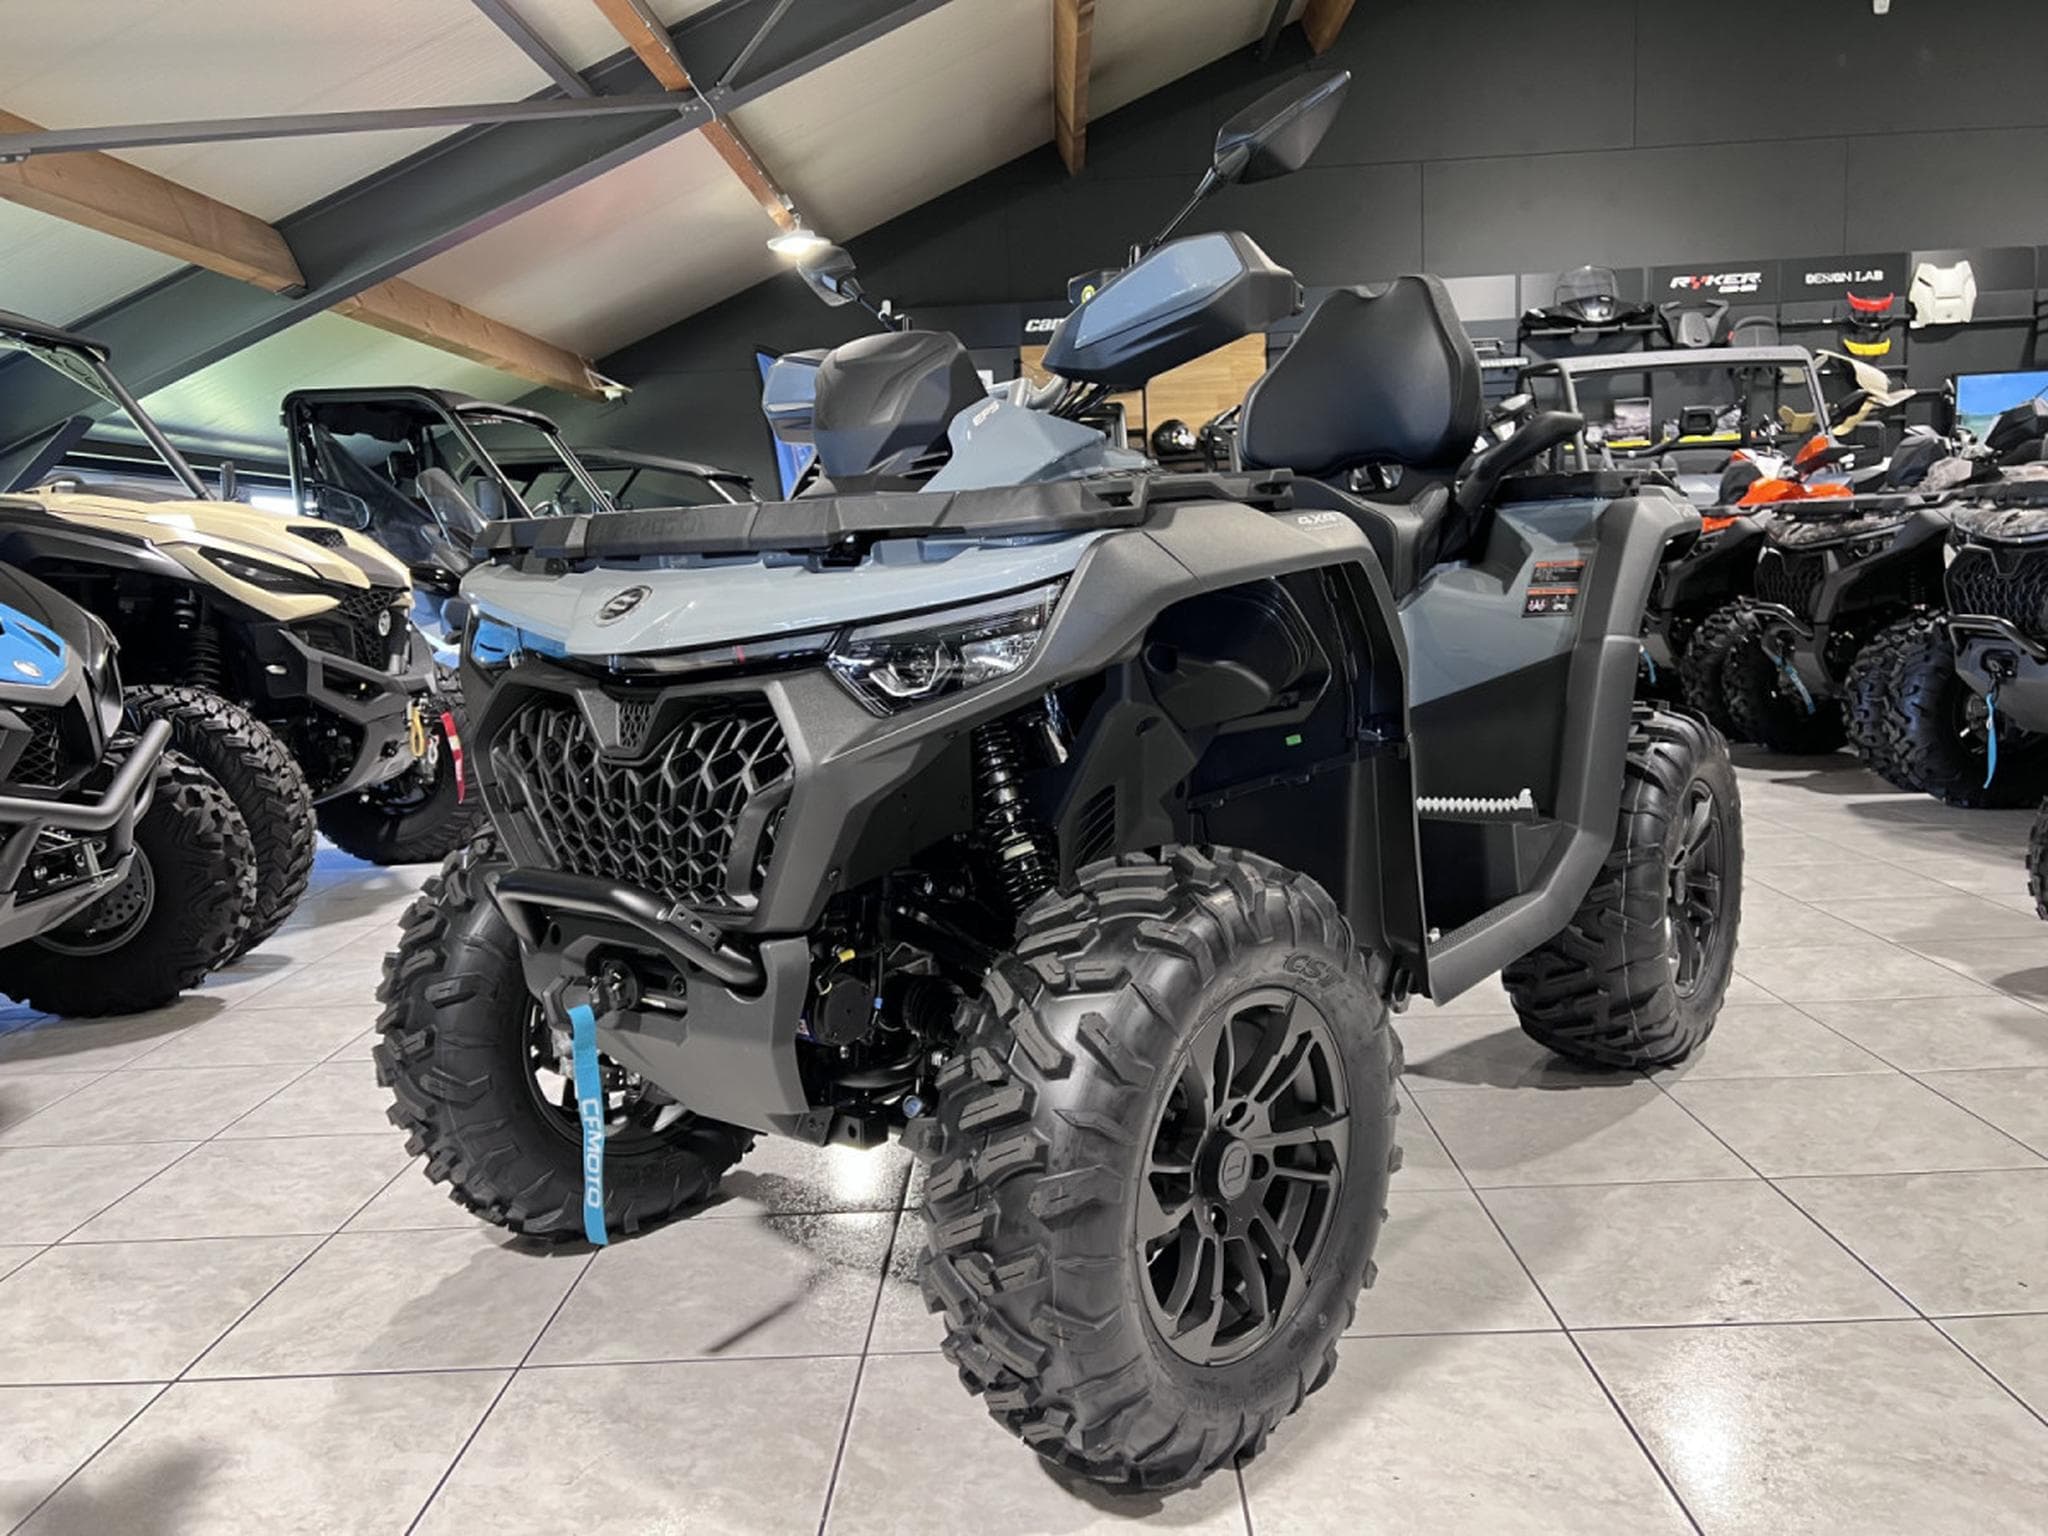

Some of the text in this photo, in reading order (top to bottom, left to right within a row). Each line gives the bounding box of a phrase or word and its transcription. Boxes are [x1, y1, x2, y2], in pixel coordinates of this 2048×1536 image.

[1805, 270, 1884, 284] DESIGN LAB
[581, 1098, 603, 1209] CFMOTO
